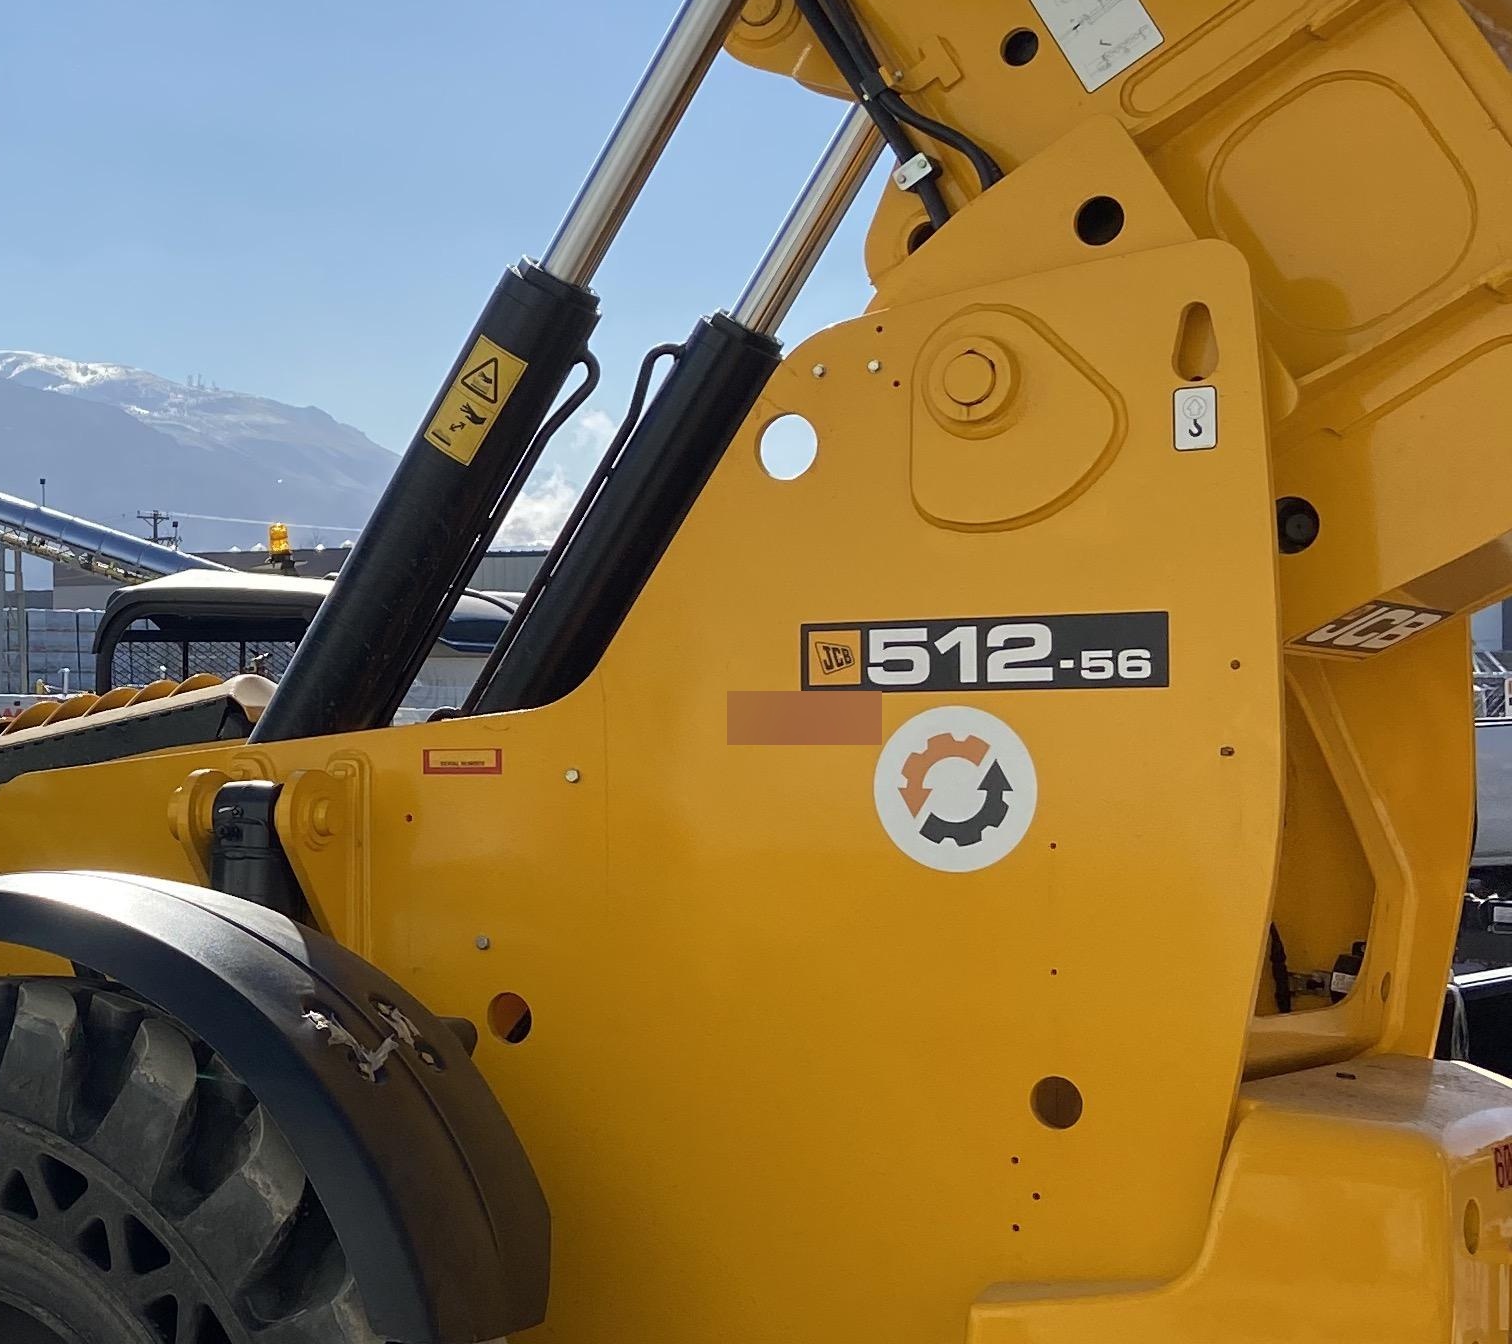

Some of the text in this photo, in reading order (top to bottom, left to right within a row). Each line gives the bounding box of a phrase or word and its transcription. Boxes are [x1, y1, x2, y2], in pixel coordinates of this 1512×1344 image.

[1306, 606, 1443, 649] JCB
[822, 623, 1152, 685] JCB 512-56
